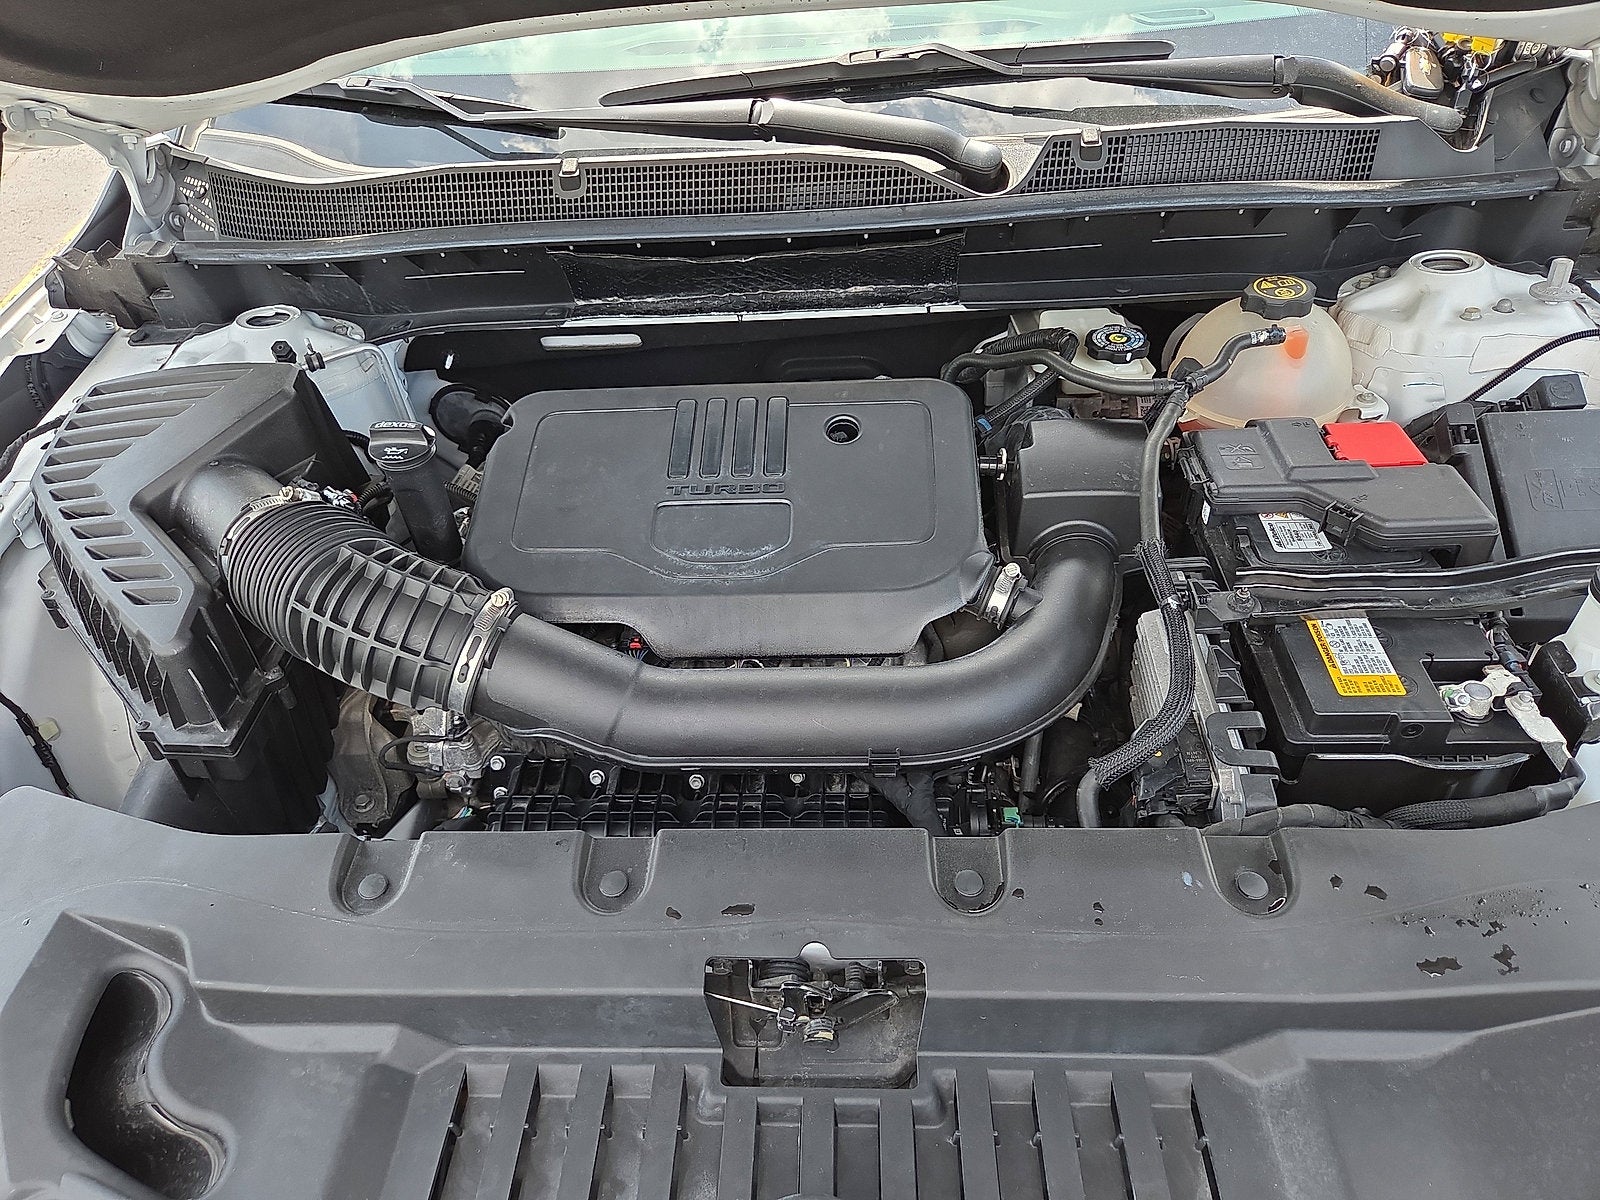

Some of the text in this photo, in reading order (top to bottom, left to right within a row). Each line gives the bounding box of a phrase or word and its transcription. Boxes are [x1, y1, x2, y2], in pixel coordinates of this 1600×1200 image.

[374, 420, 419, 429] dexos
[666, 482, 786, 496] TURBO
[1267, 522, 1284, 549] ACDelco
[1319, 642, 1335, 664] DANGER
